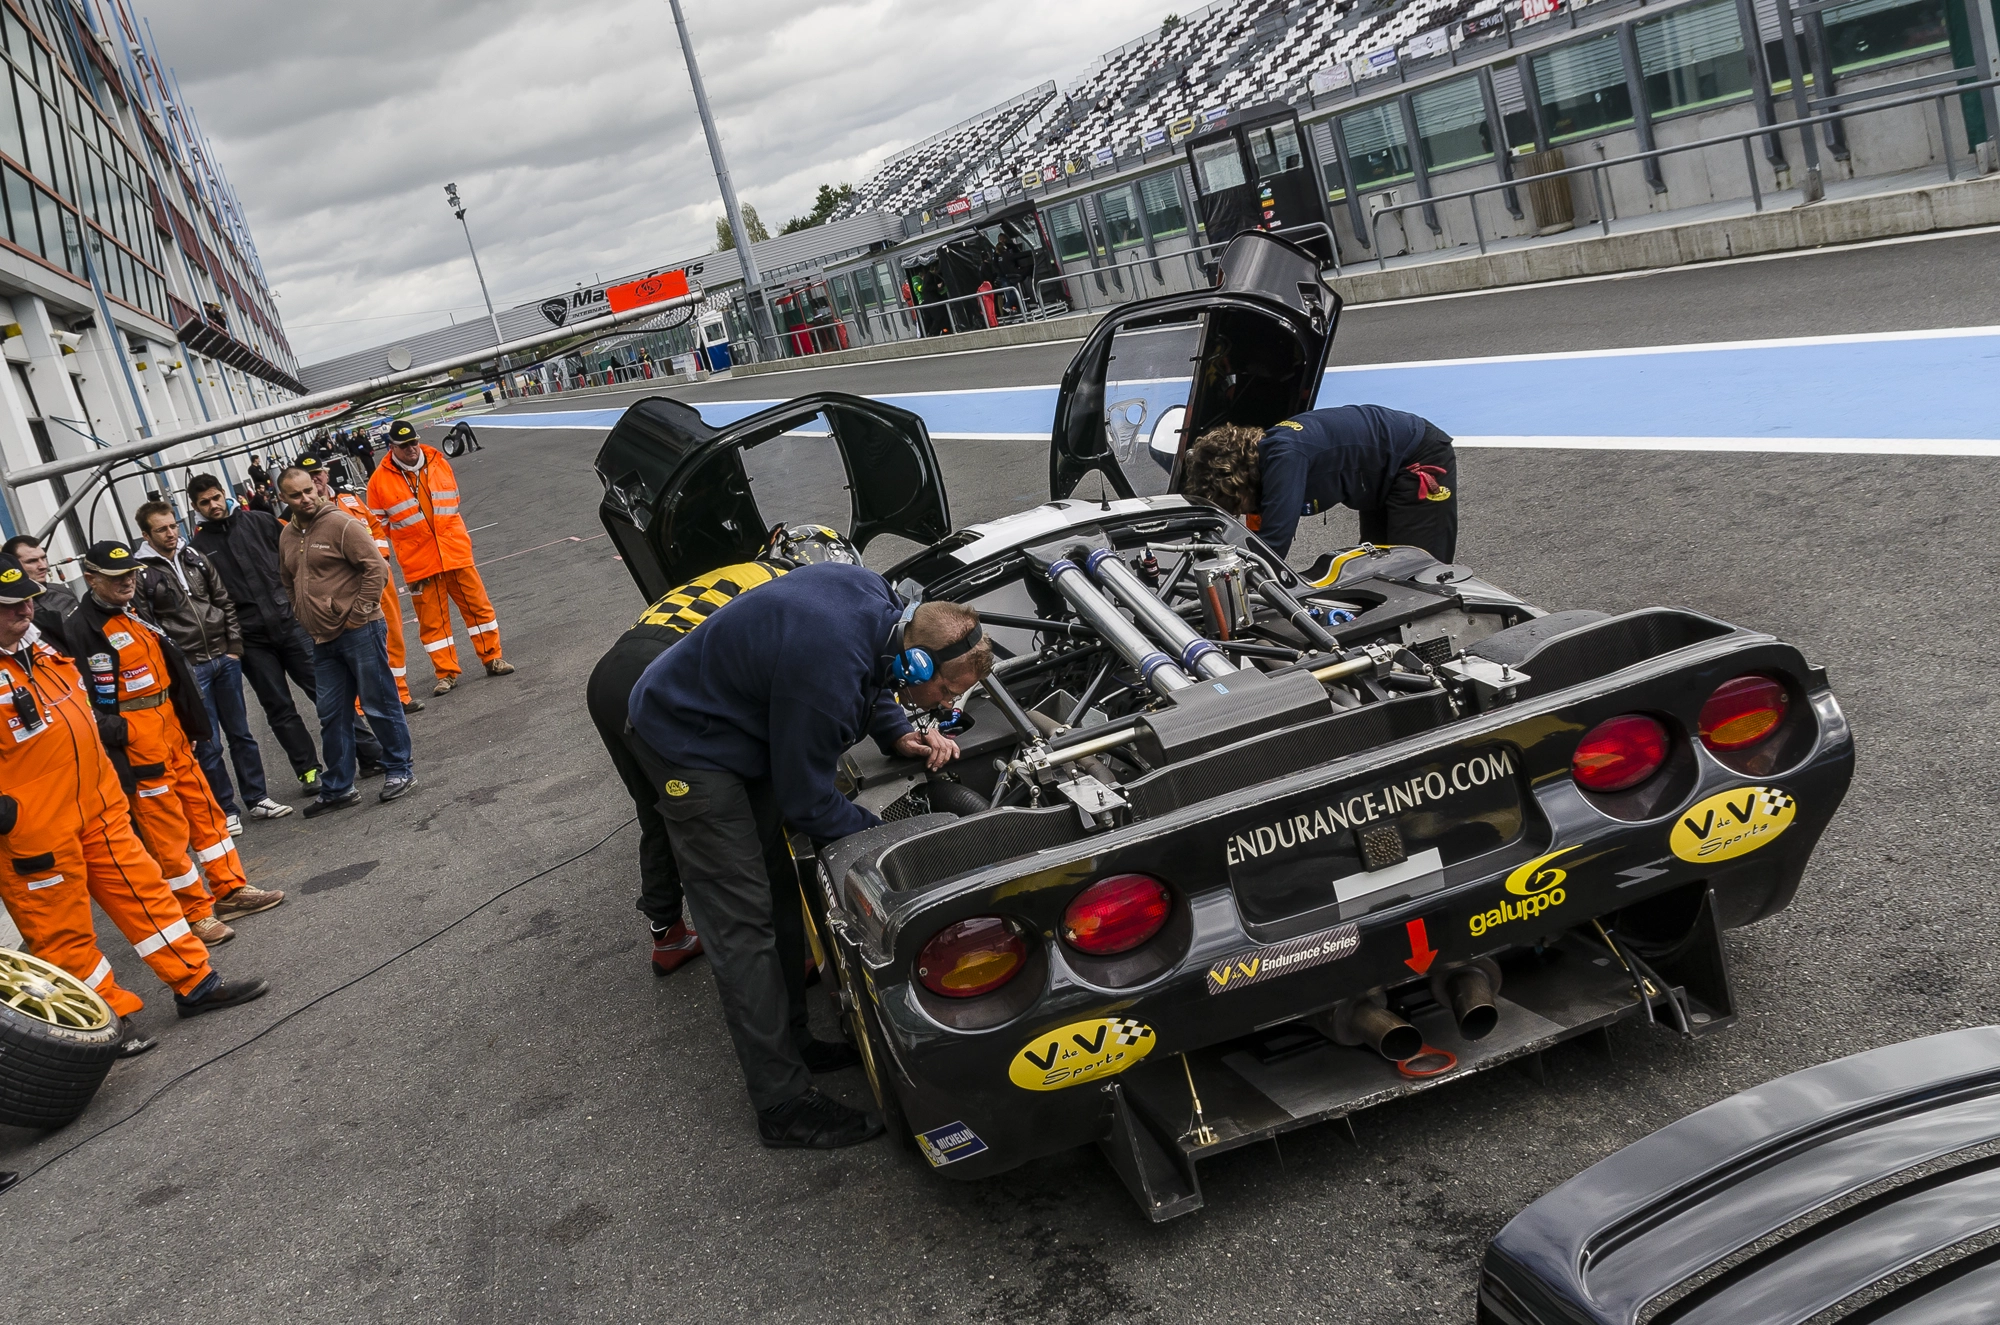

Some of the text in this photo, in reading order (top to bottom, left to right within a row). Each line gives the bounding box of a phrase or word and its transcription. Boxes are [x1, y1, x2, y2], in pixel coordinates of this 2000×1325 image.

[948, 200, 969, 214] HONDA
[131, 666, 149, 676] TOTAL
[1227, 751, 1514, 866] ENDURANCE-INFO.COM
[1684, 809, 1715, 840] V
[1726, 793, 1756, 824] V
[1697, 823, 1769, 856] Sports
[1469, 888, 1566, 937] galuppo
[1262, 947, 1320, 972] Endurance
[1322, 935, 1357, 954] Series
[1024, 1041, 1059, 1071] V
[1072, 1025, 1108, 1054] V
[1042, 1051, 1125, 1085] Sports
[936, 1128, 975, 1150] MICHELIN
